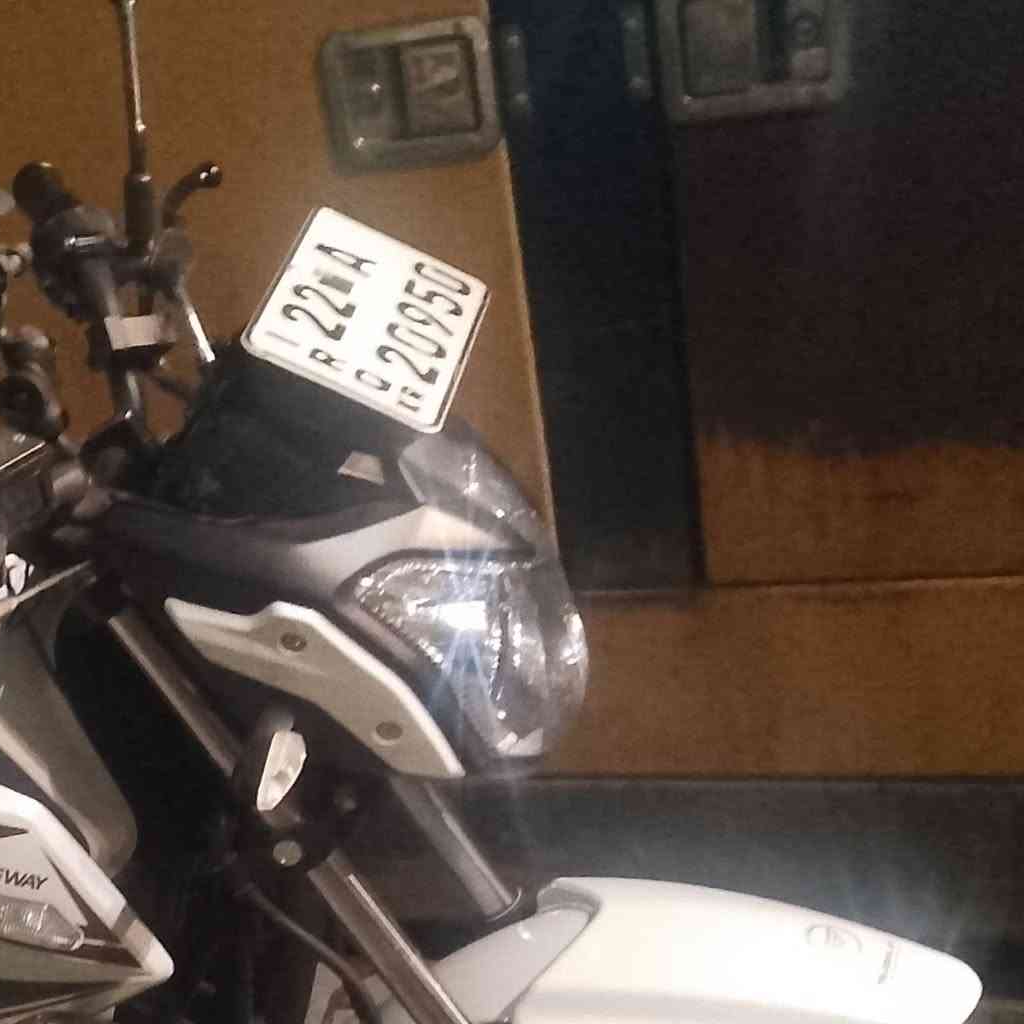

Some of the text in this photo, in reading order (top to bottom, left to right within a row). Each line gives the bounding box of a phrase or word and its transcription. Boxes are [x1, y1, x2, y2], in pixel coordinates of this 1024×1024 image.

[281, 243, 377, 342] 22 A
[377, 261, 471, 385] 20950
